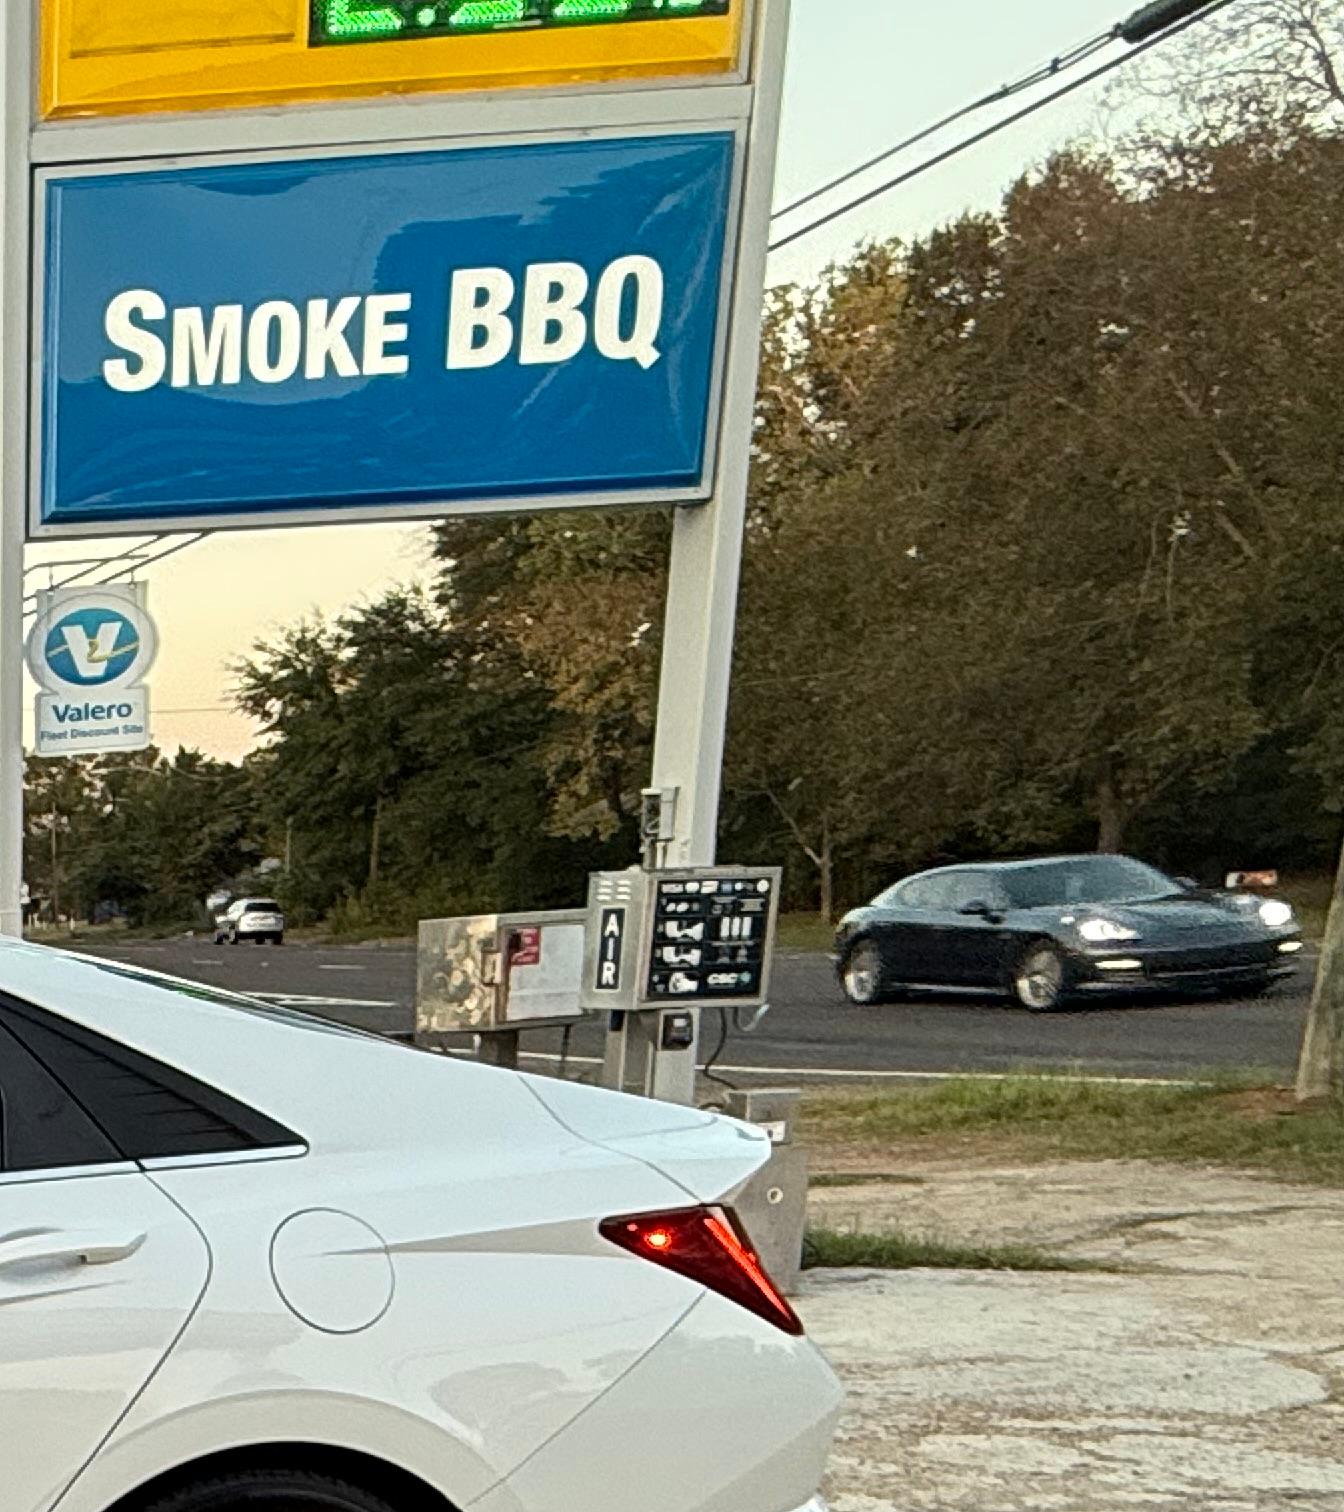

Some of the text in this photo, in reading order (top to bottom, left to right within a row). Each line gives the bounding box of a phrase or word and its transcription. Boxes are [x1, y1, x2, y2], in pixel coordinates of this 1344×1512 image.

[446, 255, 664, 369] BBQ
[52, 703, 132, 722] Valero
[602, 913, 620, 985] AIR
